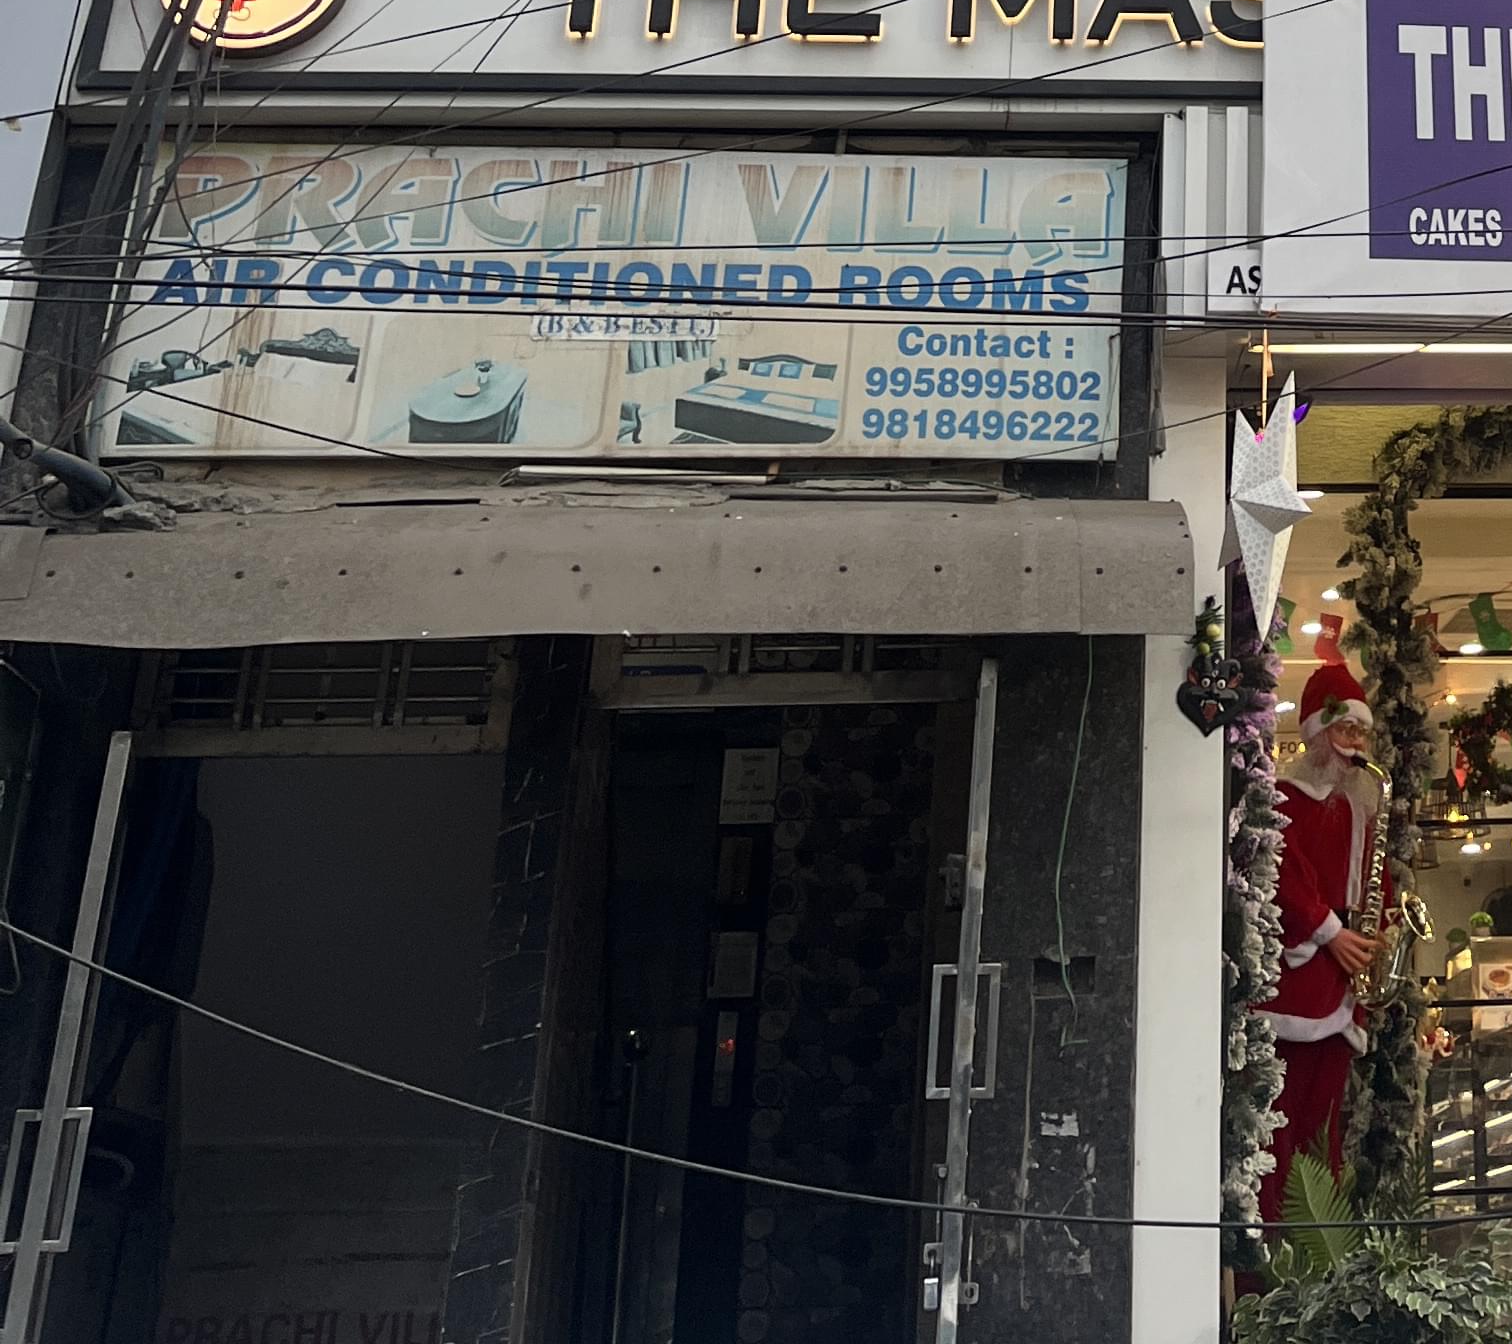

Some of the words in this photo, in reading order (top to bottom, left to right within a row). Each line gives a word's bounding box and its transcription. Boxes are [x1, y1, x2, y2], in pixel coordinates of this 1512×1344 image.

[158, 154, 690, 258] PRACHI
[737, 162, 1114, 265] VILLA
[1409, 207, 1503, 247] CAKES
[151, 258, 281, 307] AIR
[307, 258, 812, 307] CONDITIONED
[838, 263, 1091, 313] ROOMS
[897, 326, 1051, 359] Contact
[864, 366, 1101, 402] 9958995802
[862, 408, 1099, 443] 9818496222
